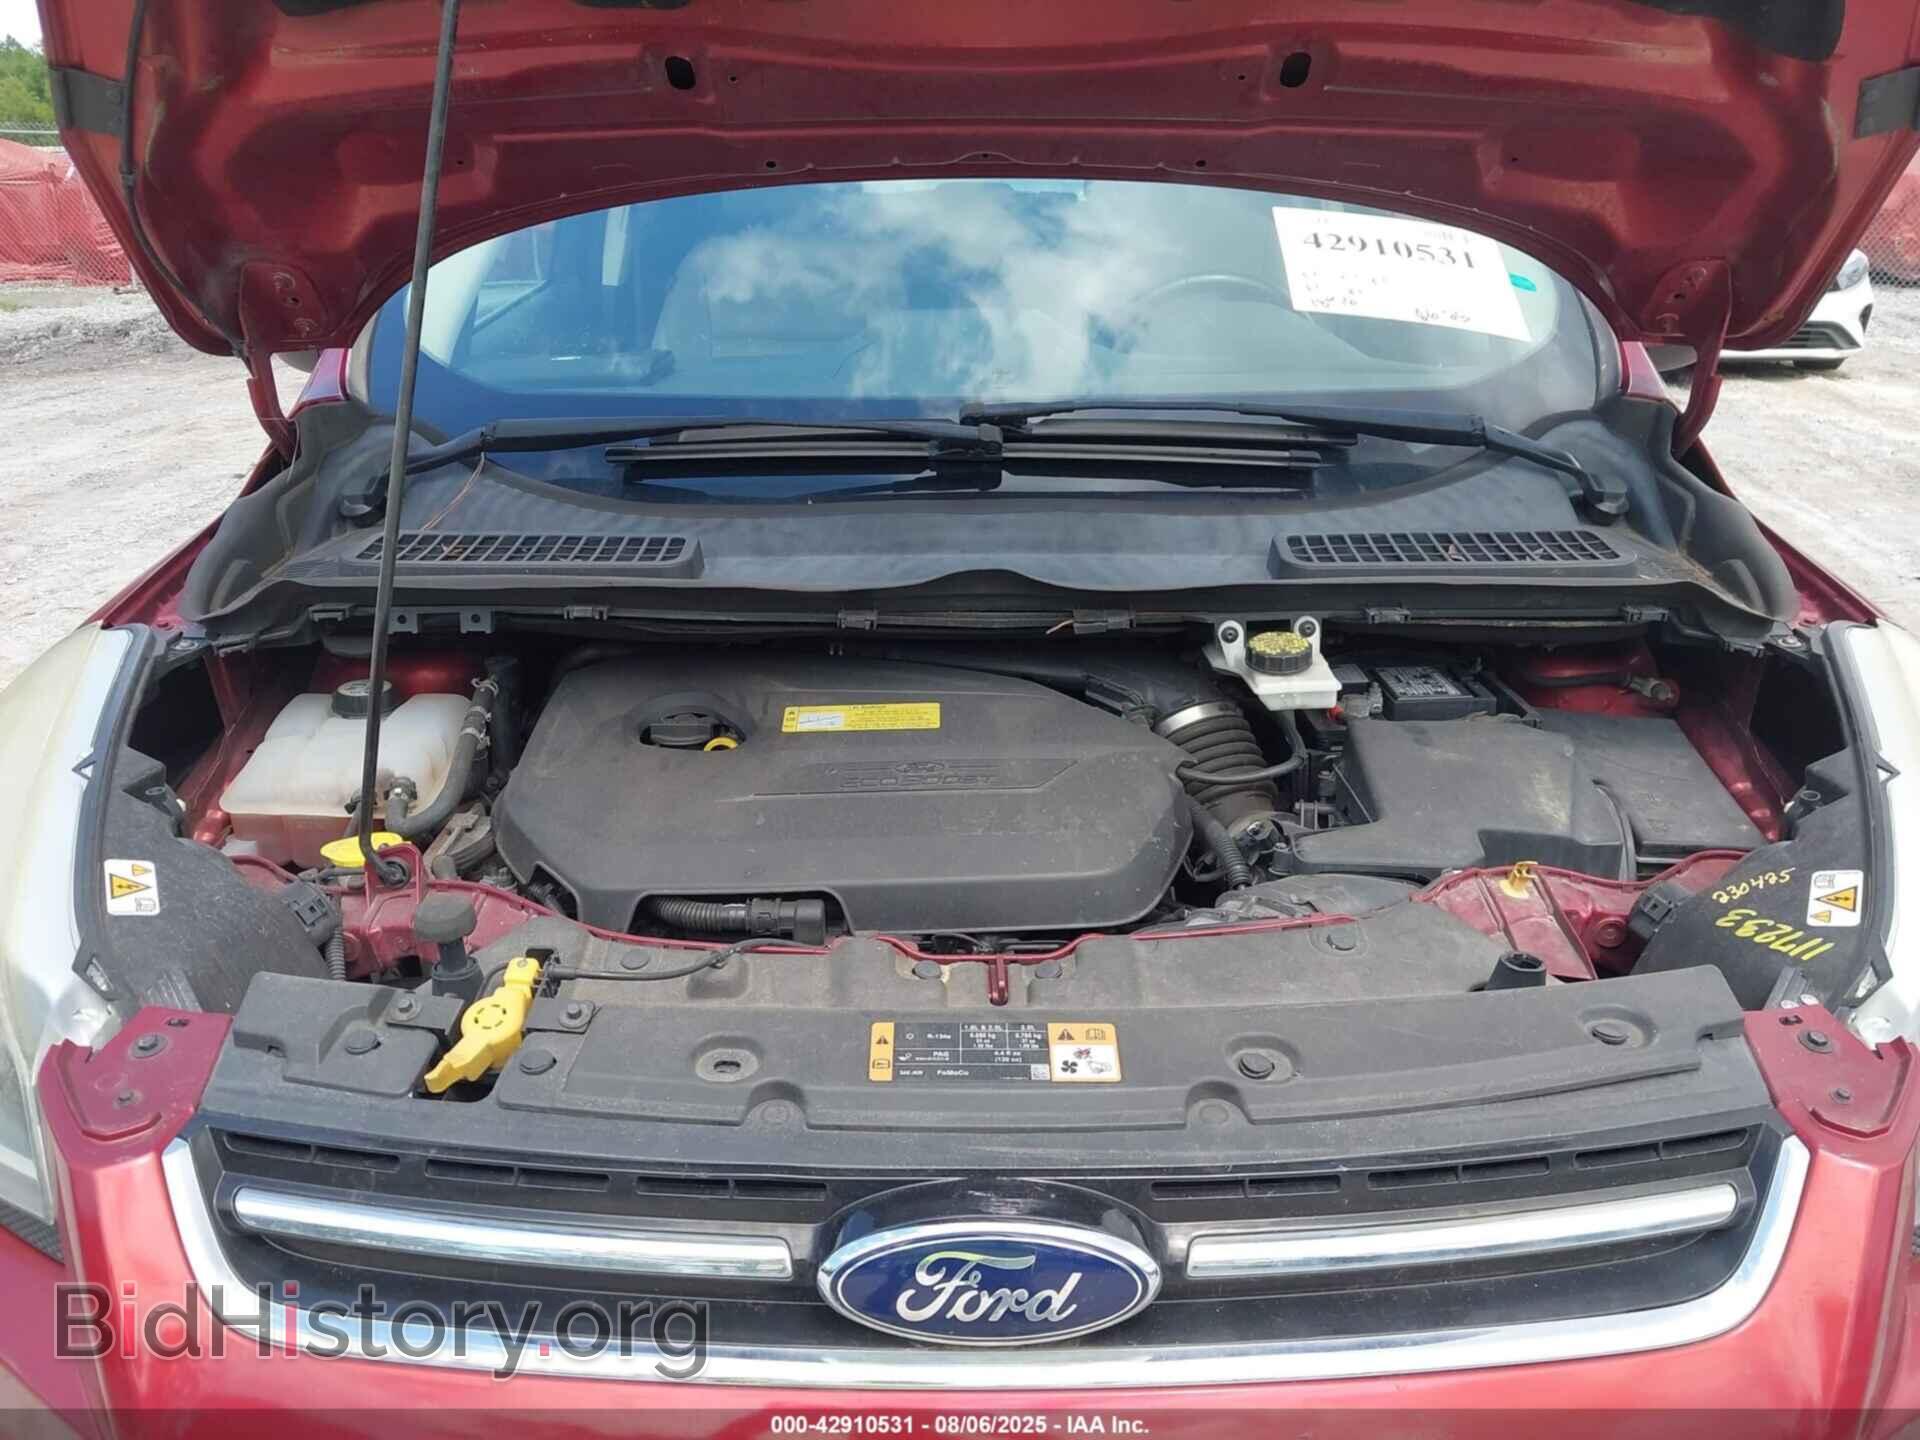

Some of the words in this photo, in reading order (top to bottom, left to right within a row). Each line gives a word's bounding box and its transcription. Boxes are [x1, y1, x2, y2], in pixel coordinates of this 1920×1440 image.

[1303, 232, 1475, 269] 42910531
[1712, 866, 1797, 904] 230425
[895, 1251, 1082, 1323] Ford
